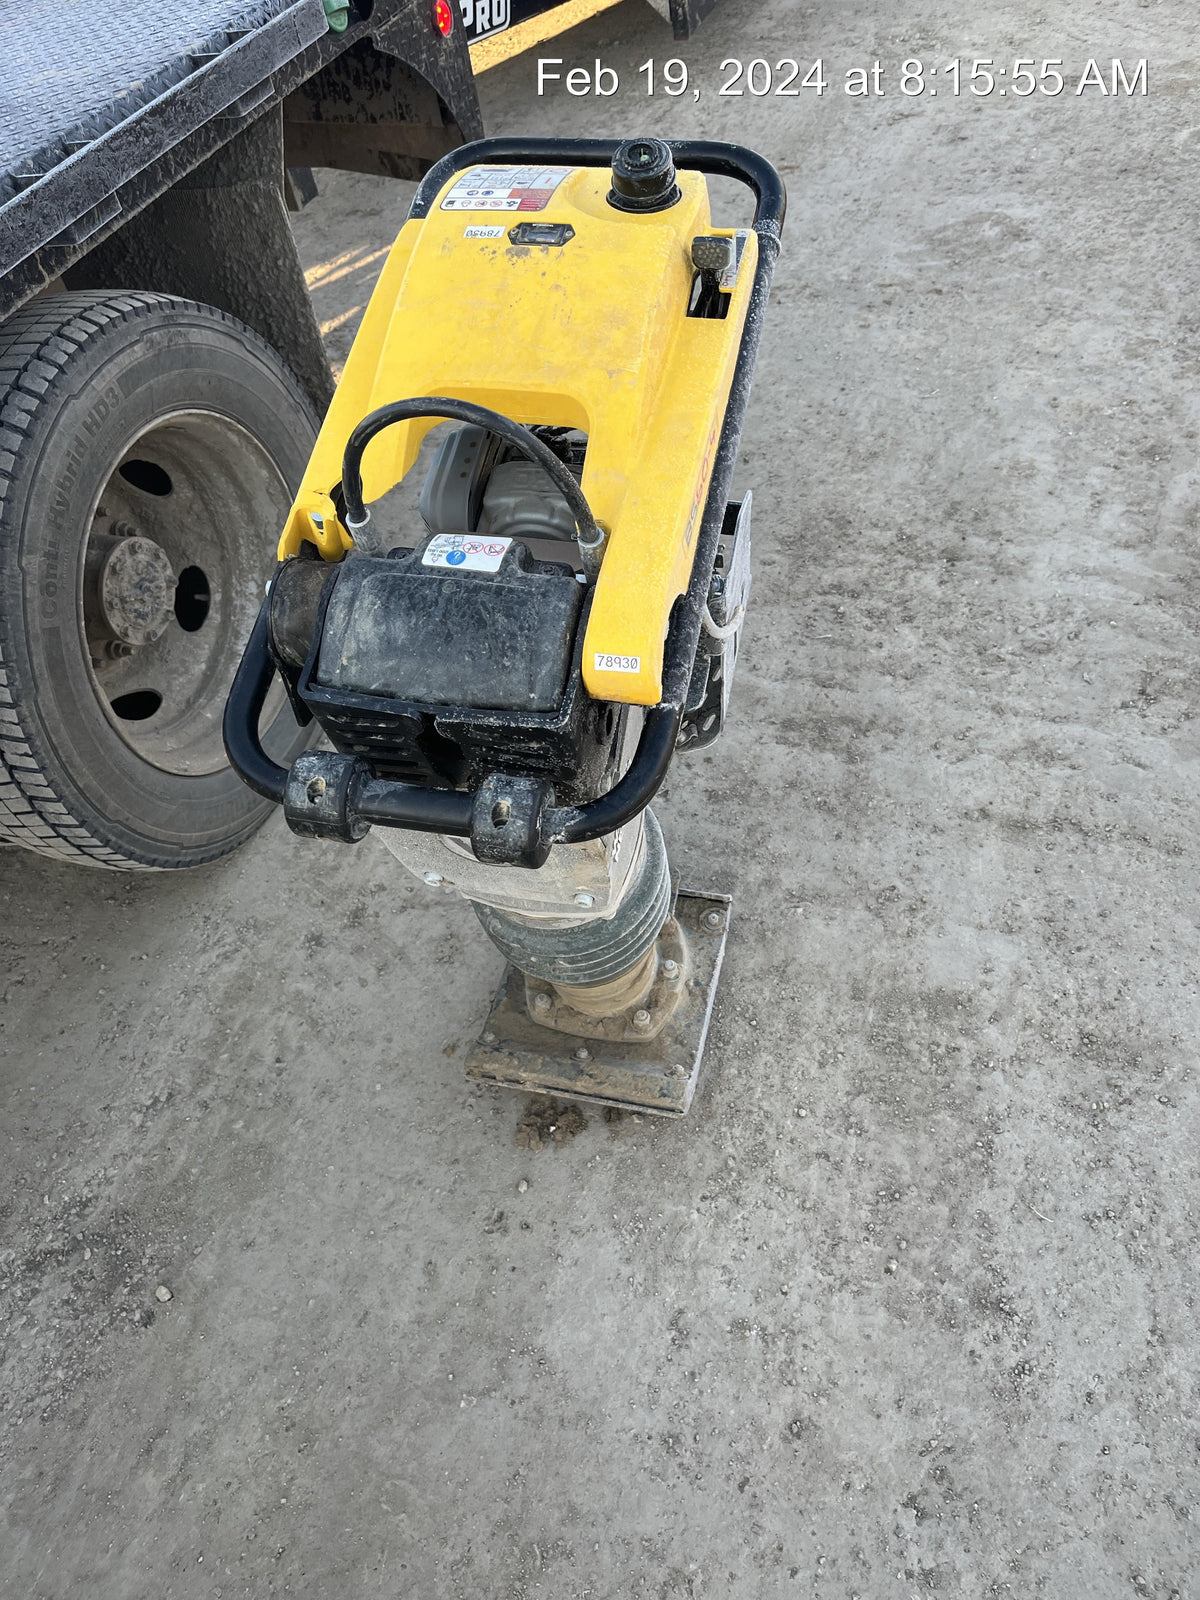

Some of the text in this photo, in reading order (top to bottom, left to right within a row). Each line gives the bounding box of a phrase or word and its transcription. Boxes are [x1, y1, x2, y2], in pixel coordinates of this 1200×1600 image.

[48, 433, 88, 531] Hybrid
[83, 386, 121, 437] HD3
[597, 655, 638, 670] 78930
